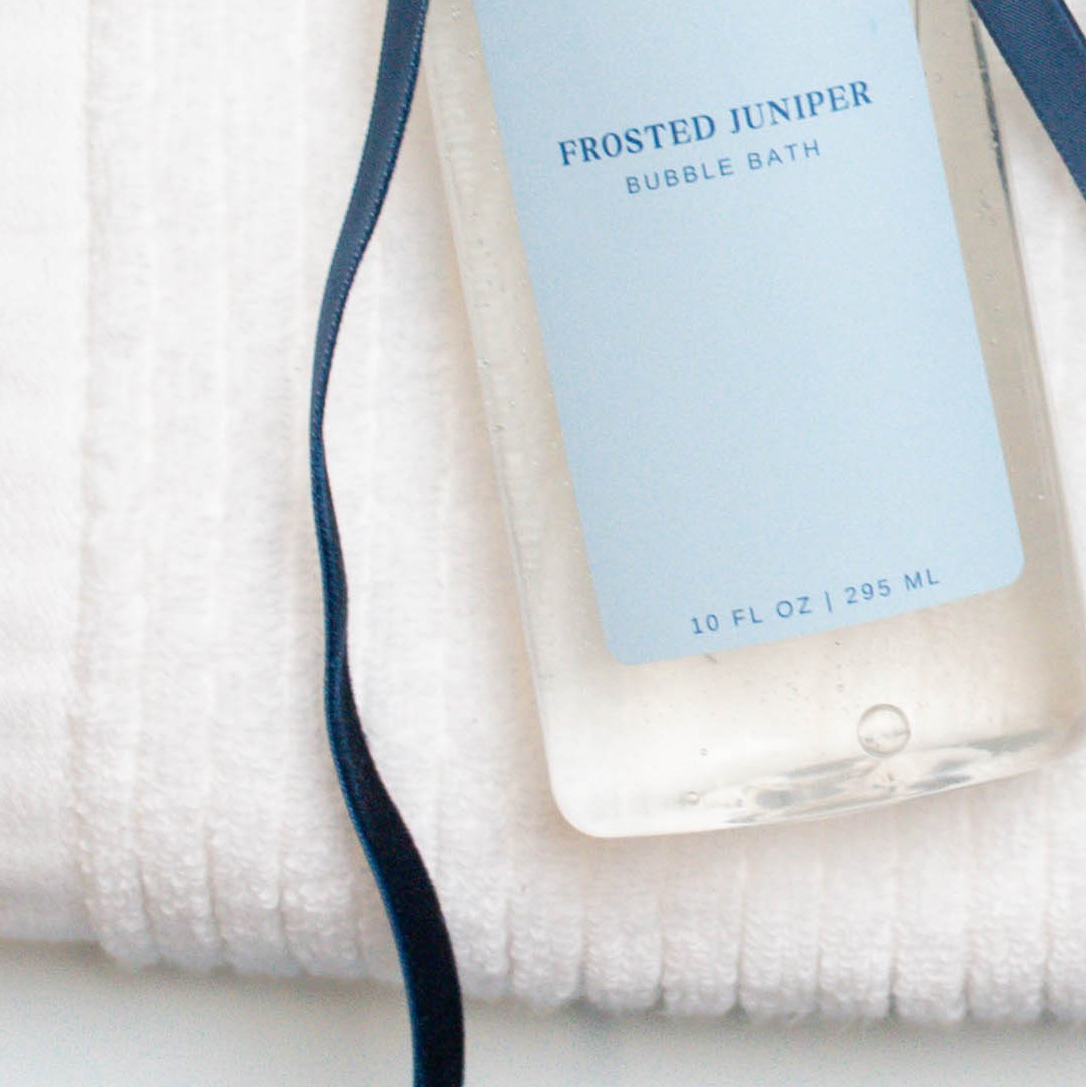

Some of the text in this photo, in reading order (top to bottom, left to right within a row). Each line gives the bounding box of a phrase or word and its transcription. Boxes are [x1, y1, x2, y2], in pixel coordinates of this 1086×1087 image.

[557, 80, 873, 167] FROSTED JUNIPER
[625, 139, 820, 195] BUBBLE BATH
[690, 613, 720, 635] 10
[731, 606, 764, 627] FL
[775, 596, 812, 620] OZ
[844, 578, 892, 605] 295
[903, 568, 940, 591] ML
